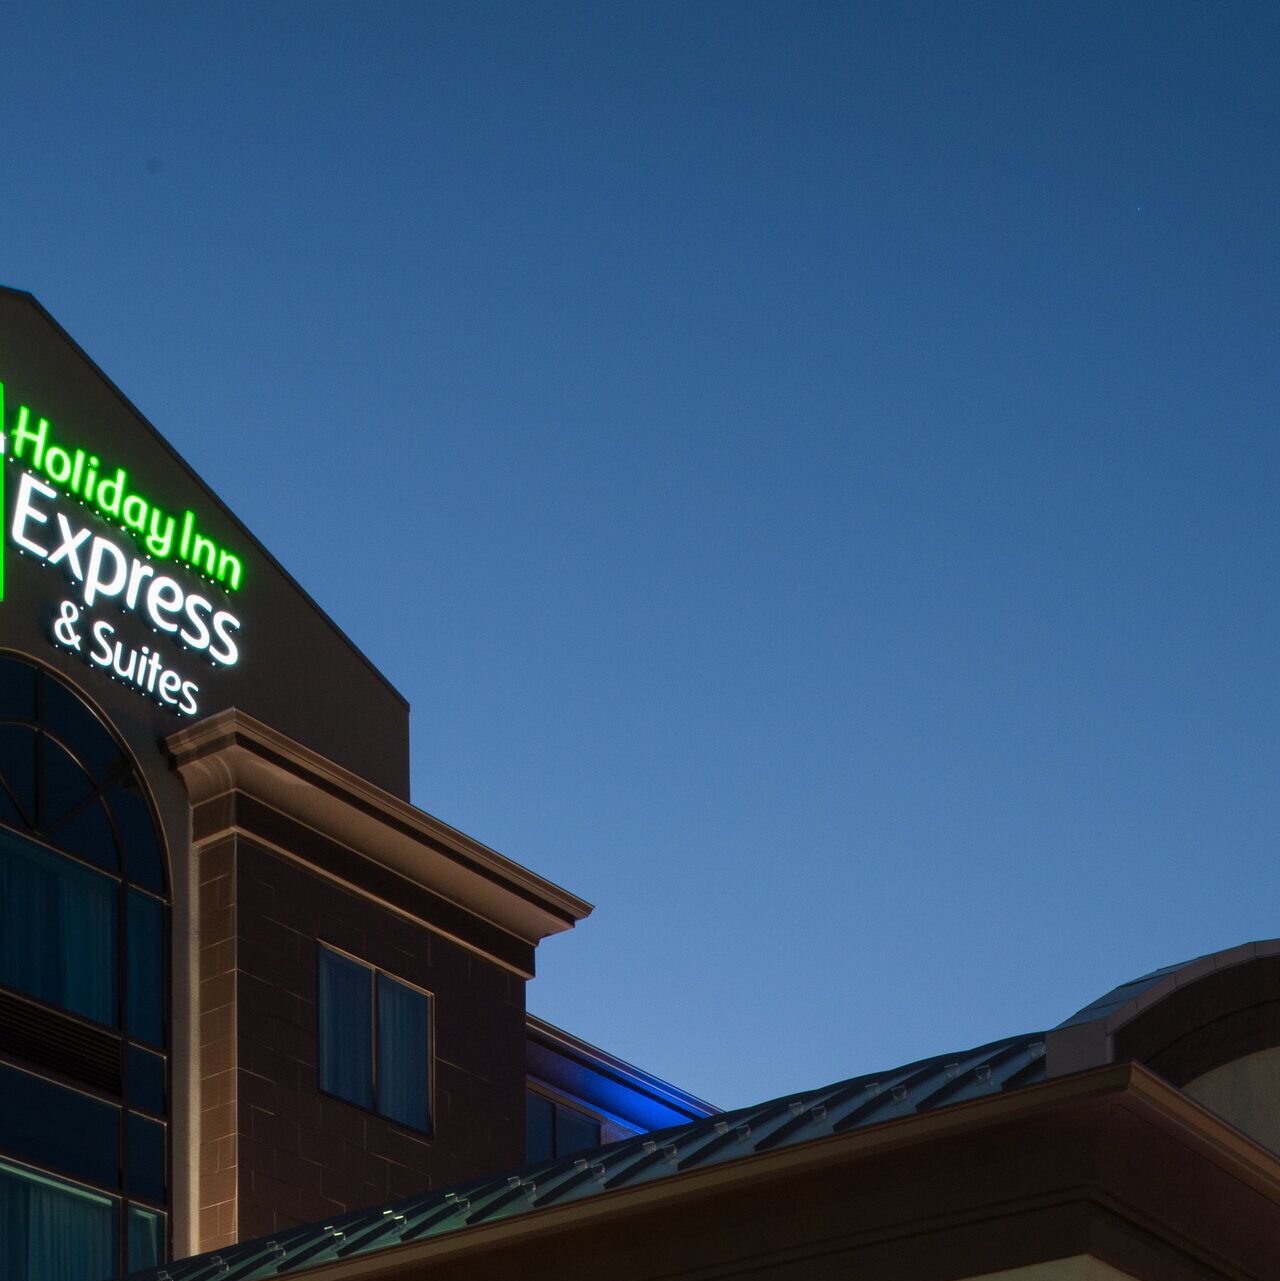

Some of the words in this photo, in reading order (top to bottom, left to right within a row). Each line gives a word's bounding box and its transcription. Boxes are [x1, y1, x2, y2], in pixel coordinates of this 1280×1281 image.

[12, 406, 176, 558] Holiday
[180, 511, 242, 590] Inn
[12, 473, 240, 666] Express
[53, 600, 82, 651] &
[90, 621, 200, 716] Suites
